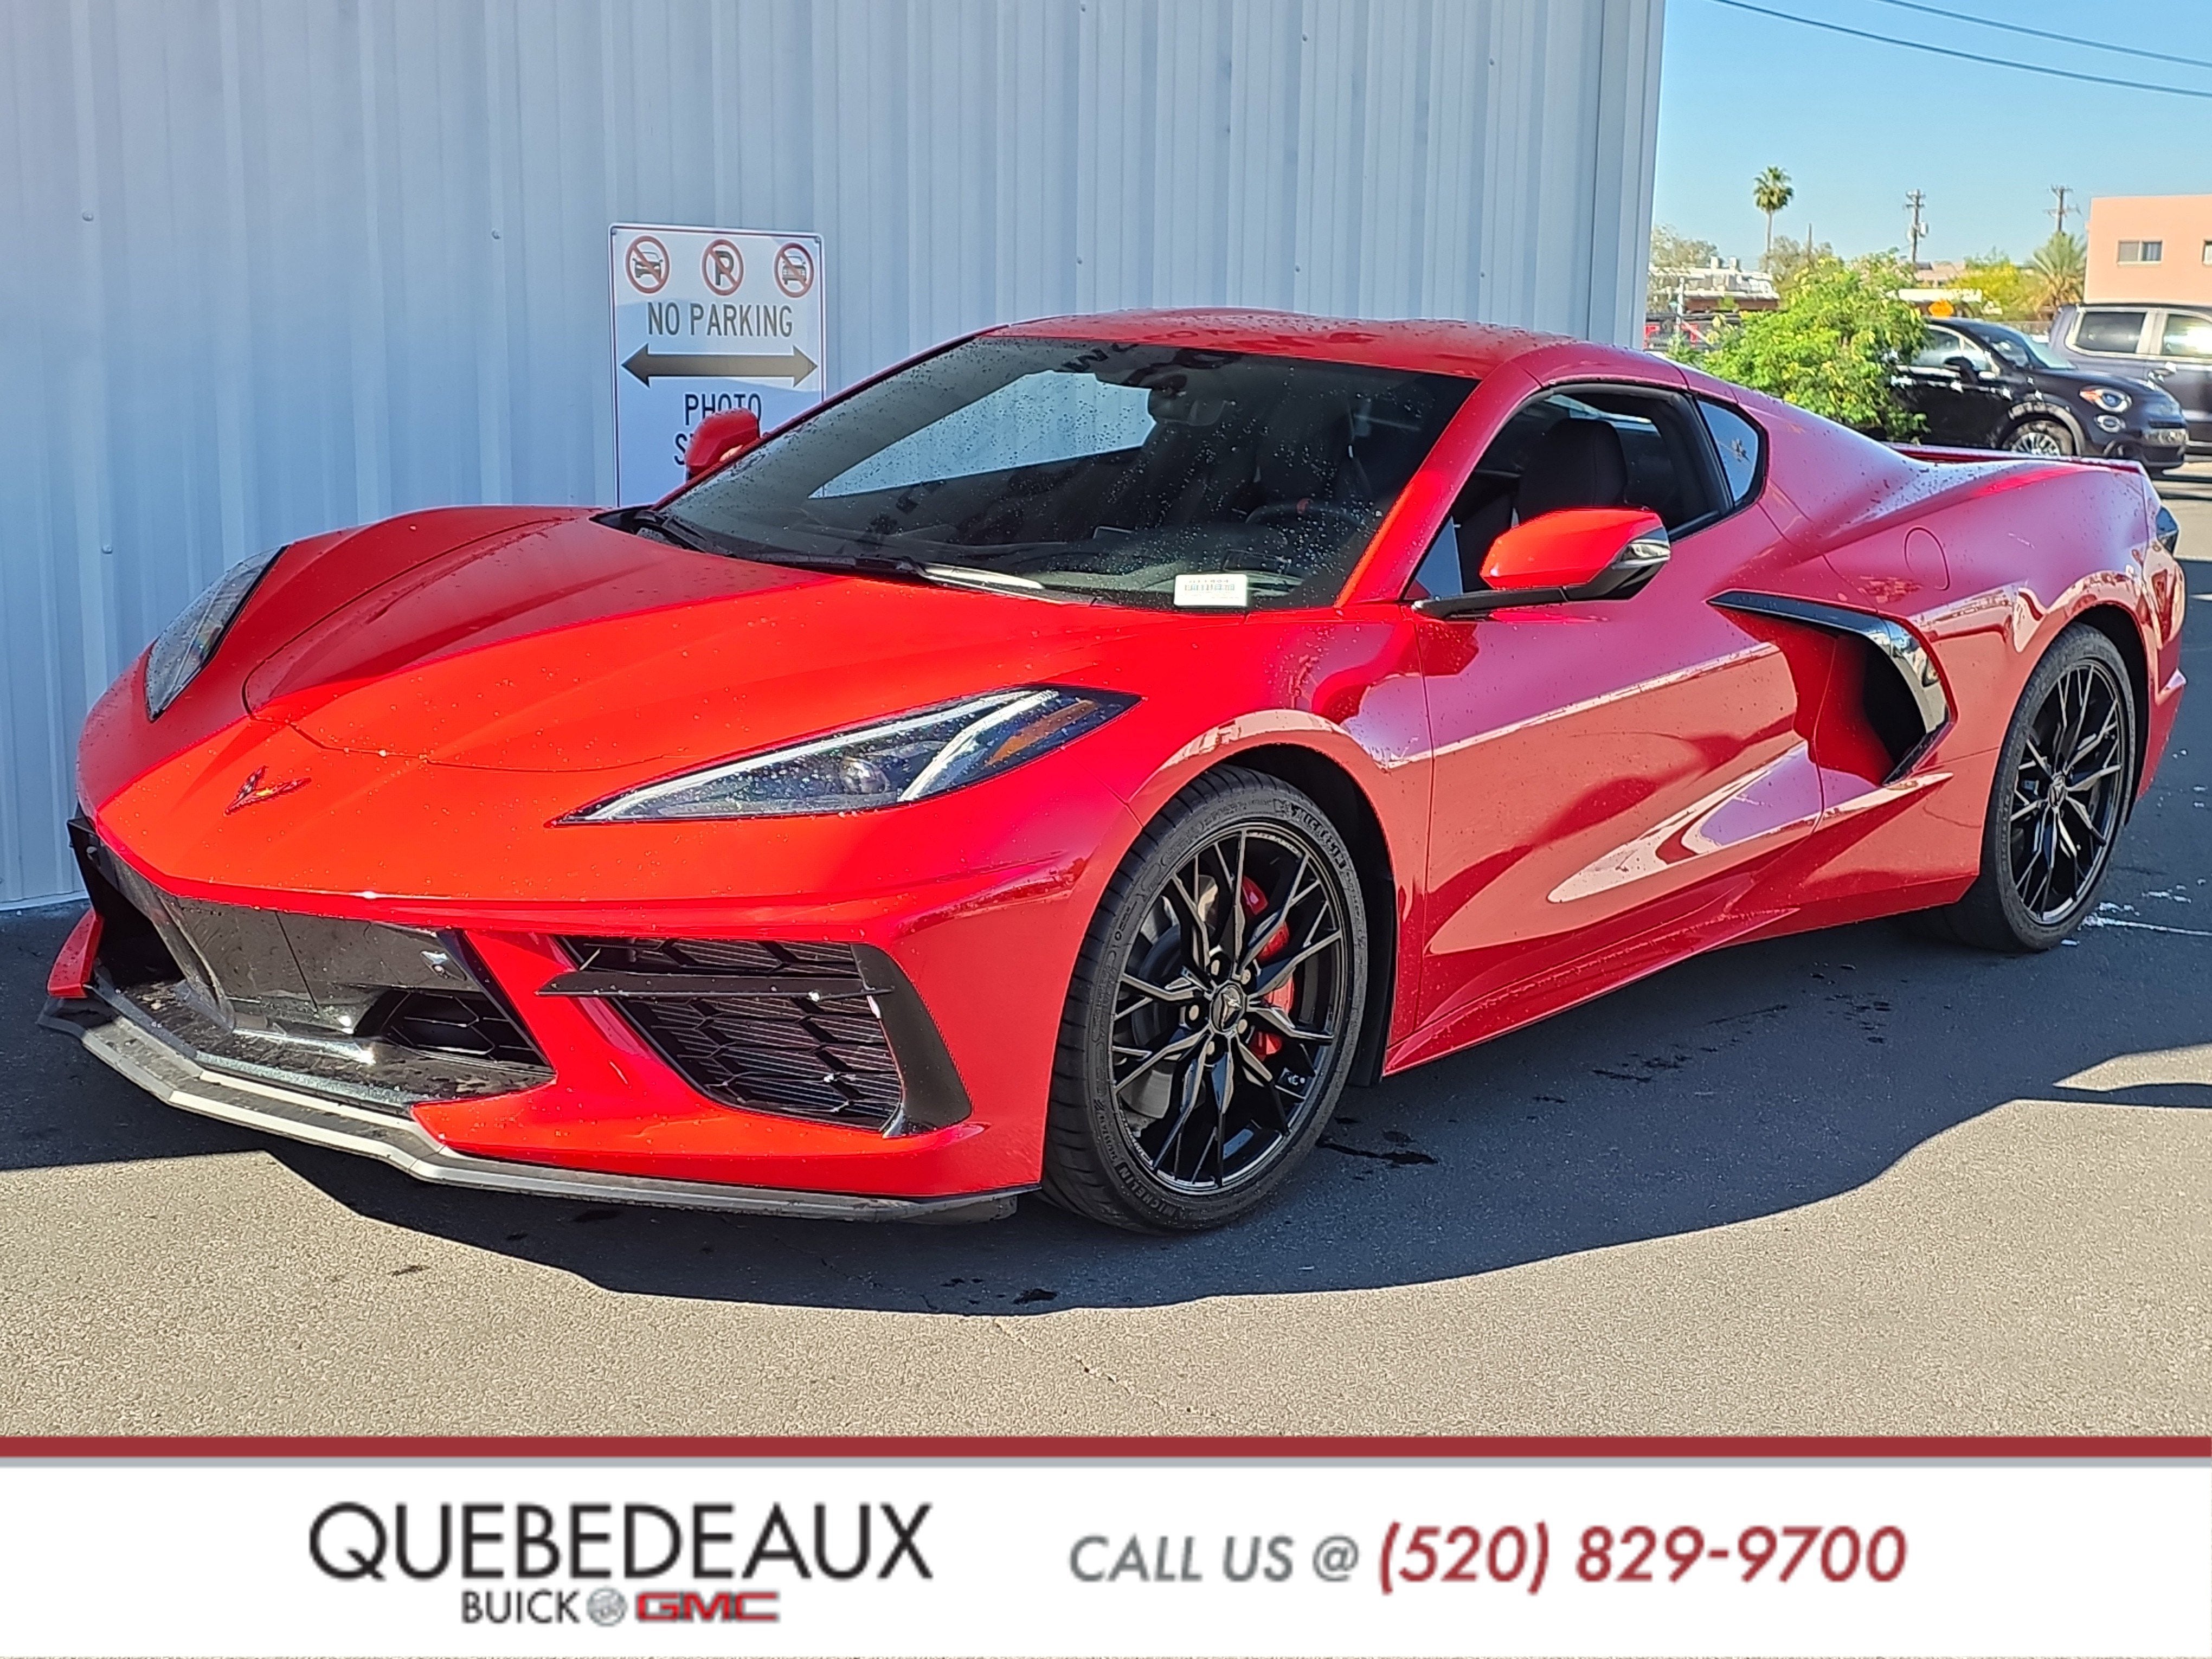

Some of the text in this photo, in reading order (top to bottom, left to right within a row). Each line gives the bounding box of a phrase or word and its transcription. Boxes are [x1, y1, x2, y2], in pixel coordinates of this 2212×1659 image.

[648, 302, 793, 337] NO PARKING
[685, 393, 762, 426] PHOTO
[1118, 1166, 1176, 1217] MICHELIN
